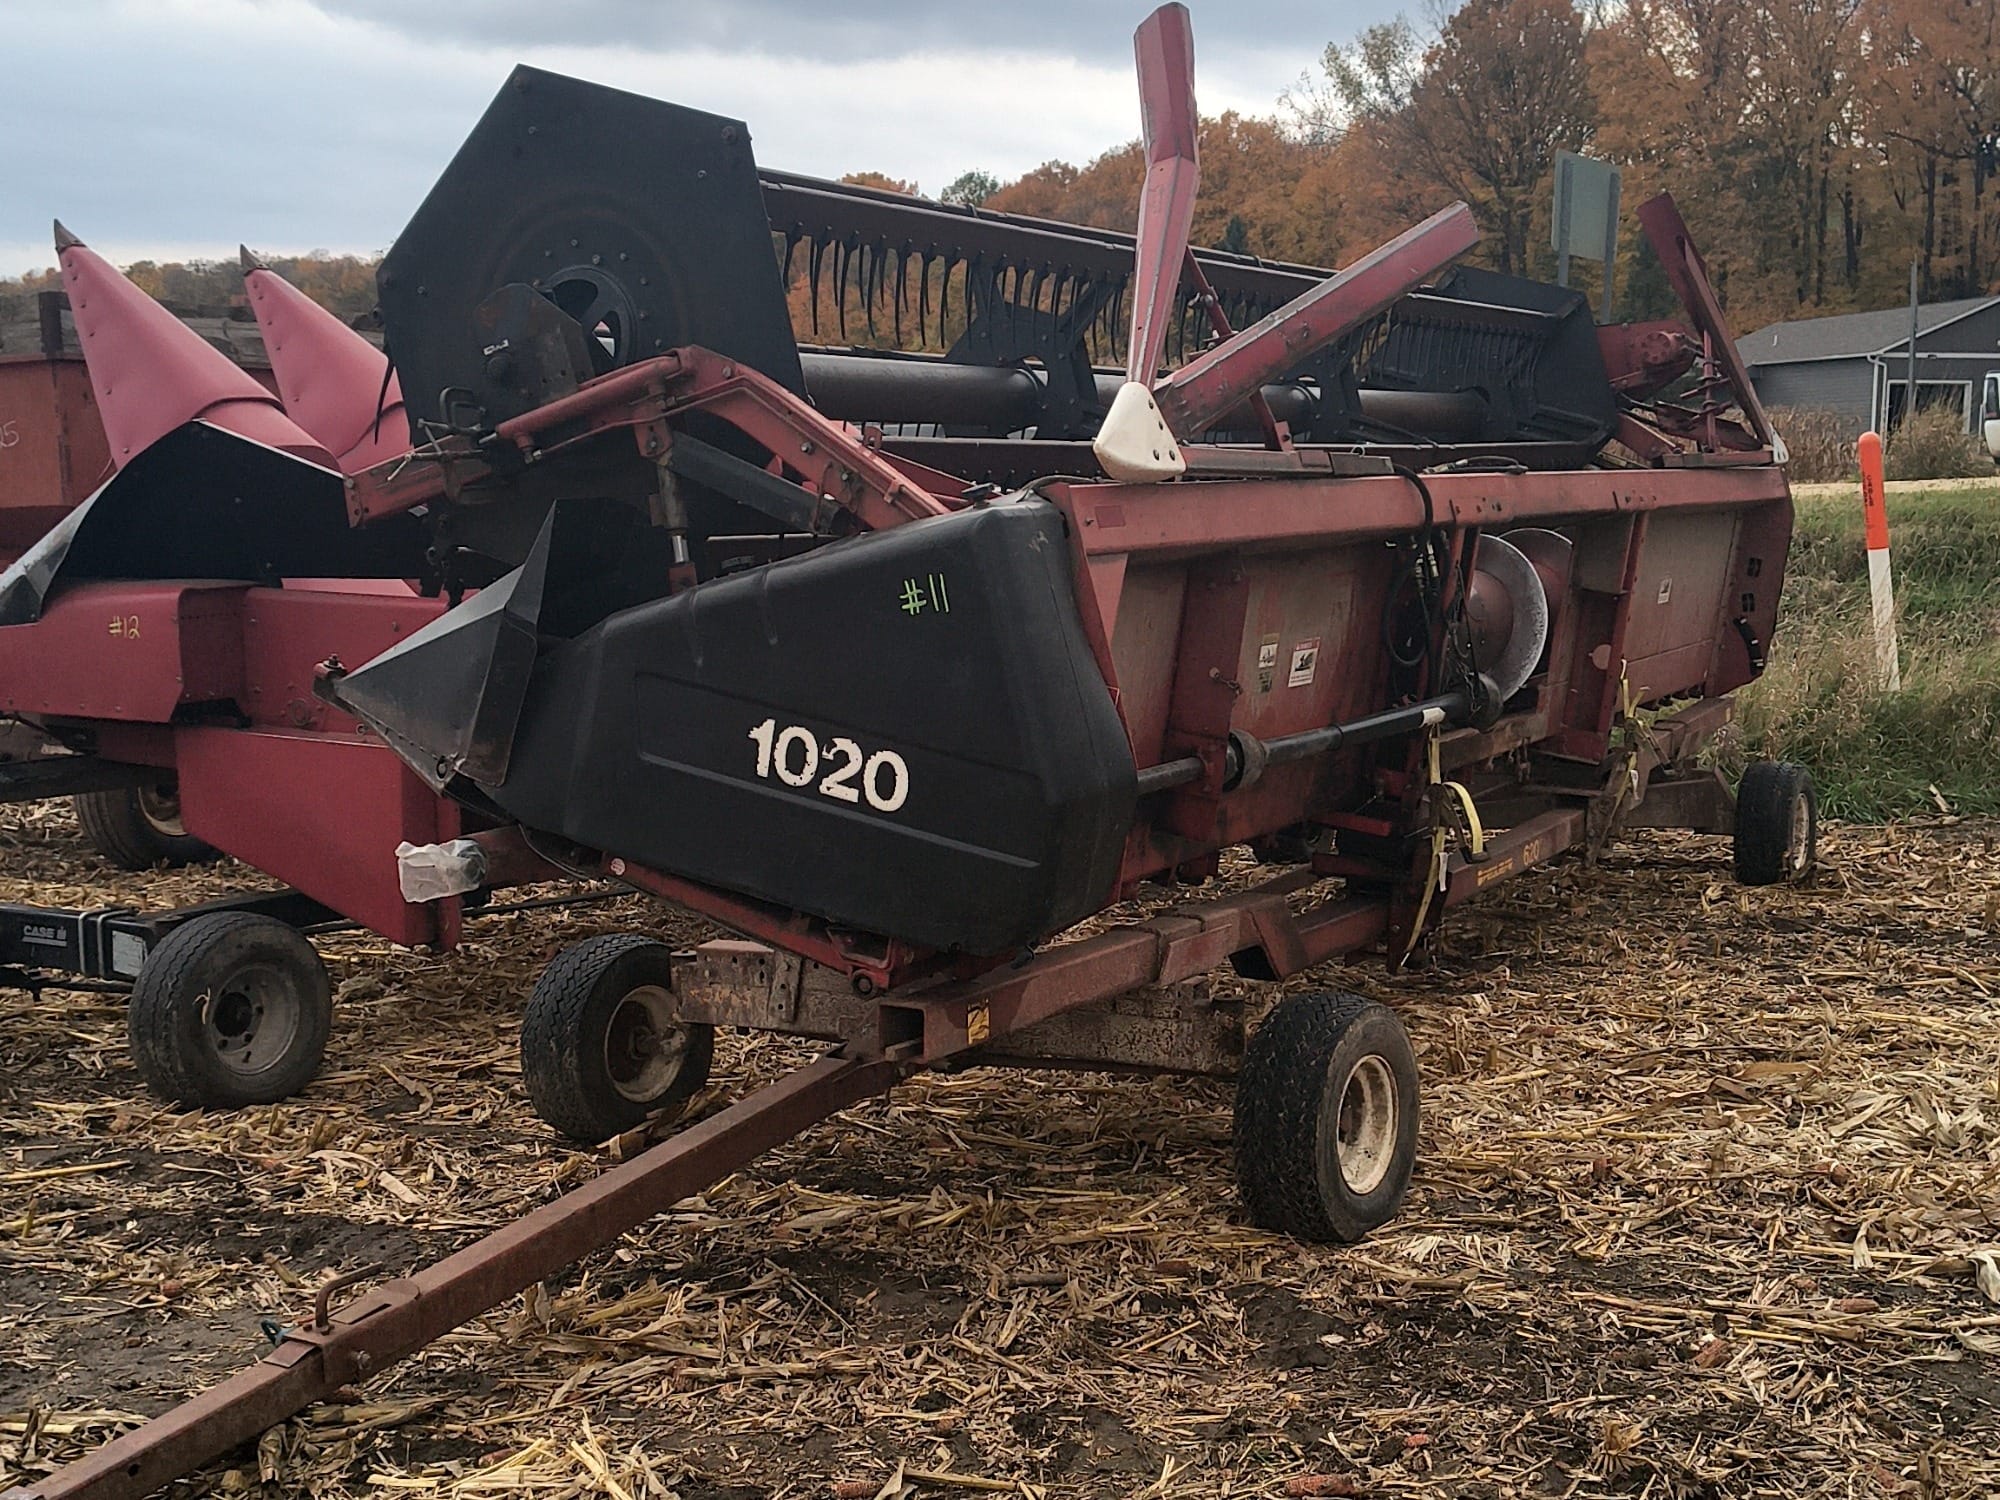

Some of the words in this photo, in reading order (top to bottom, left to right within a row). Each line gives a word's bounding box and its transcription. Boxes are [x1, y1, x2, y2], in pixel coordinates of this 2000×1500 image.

[0, 419, 20, 448] 5
[899, 573, 949, 615] #11
[108, 615, 141, 640] #12
[748, 718, 909, 812] 1020
[23, 924, 55, 939] CASE
